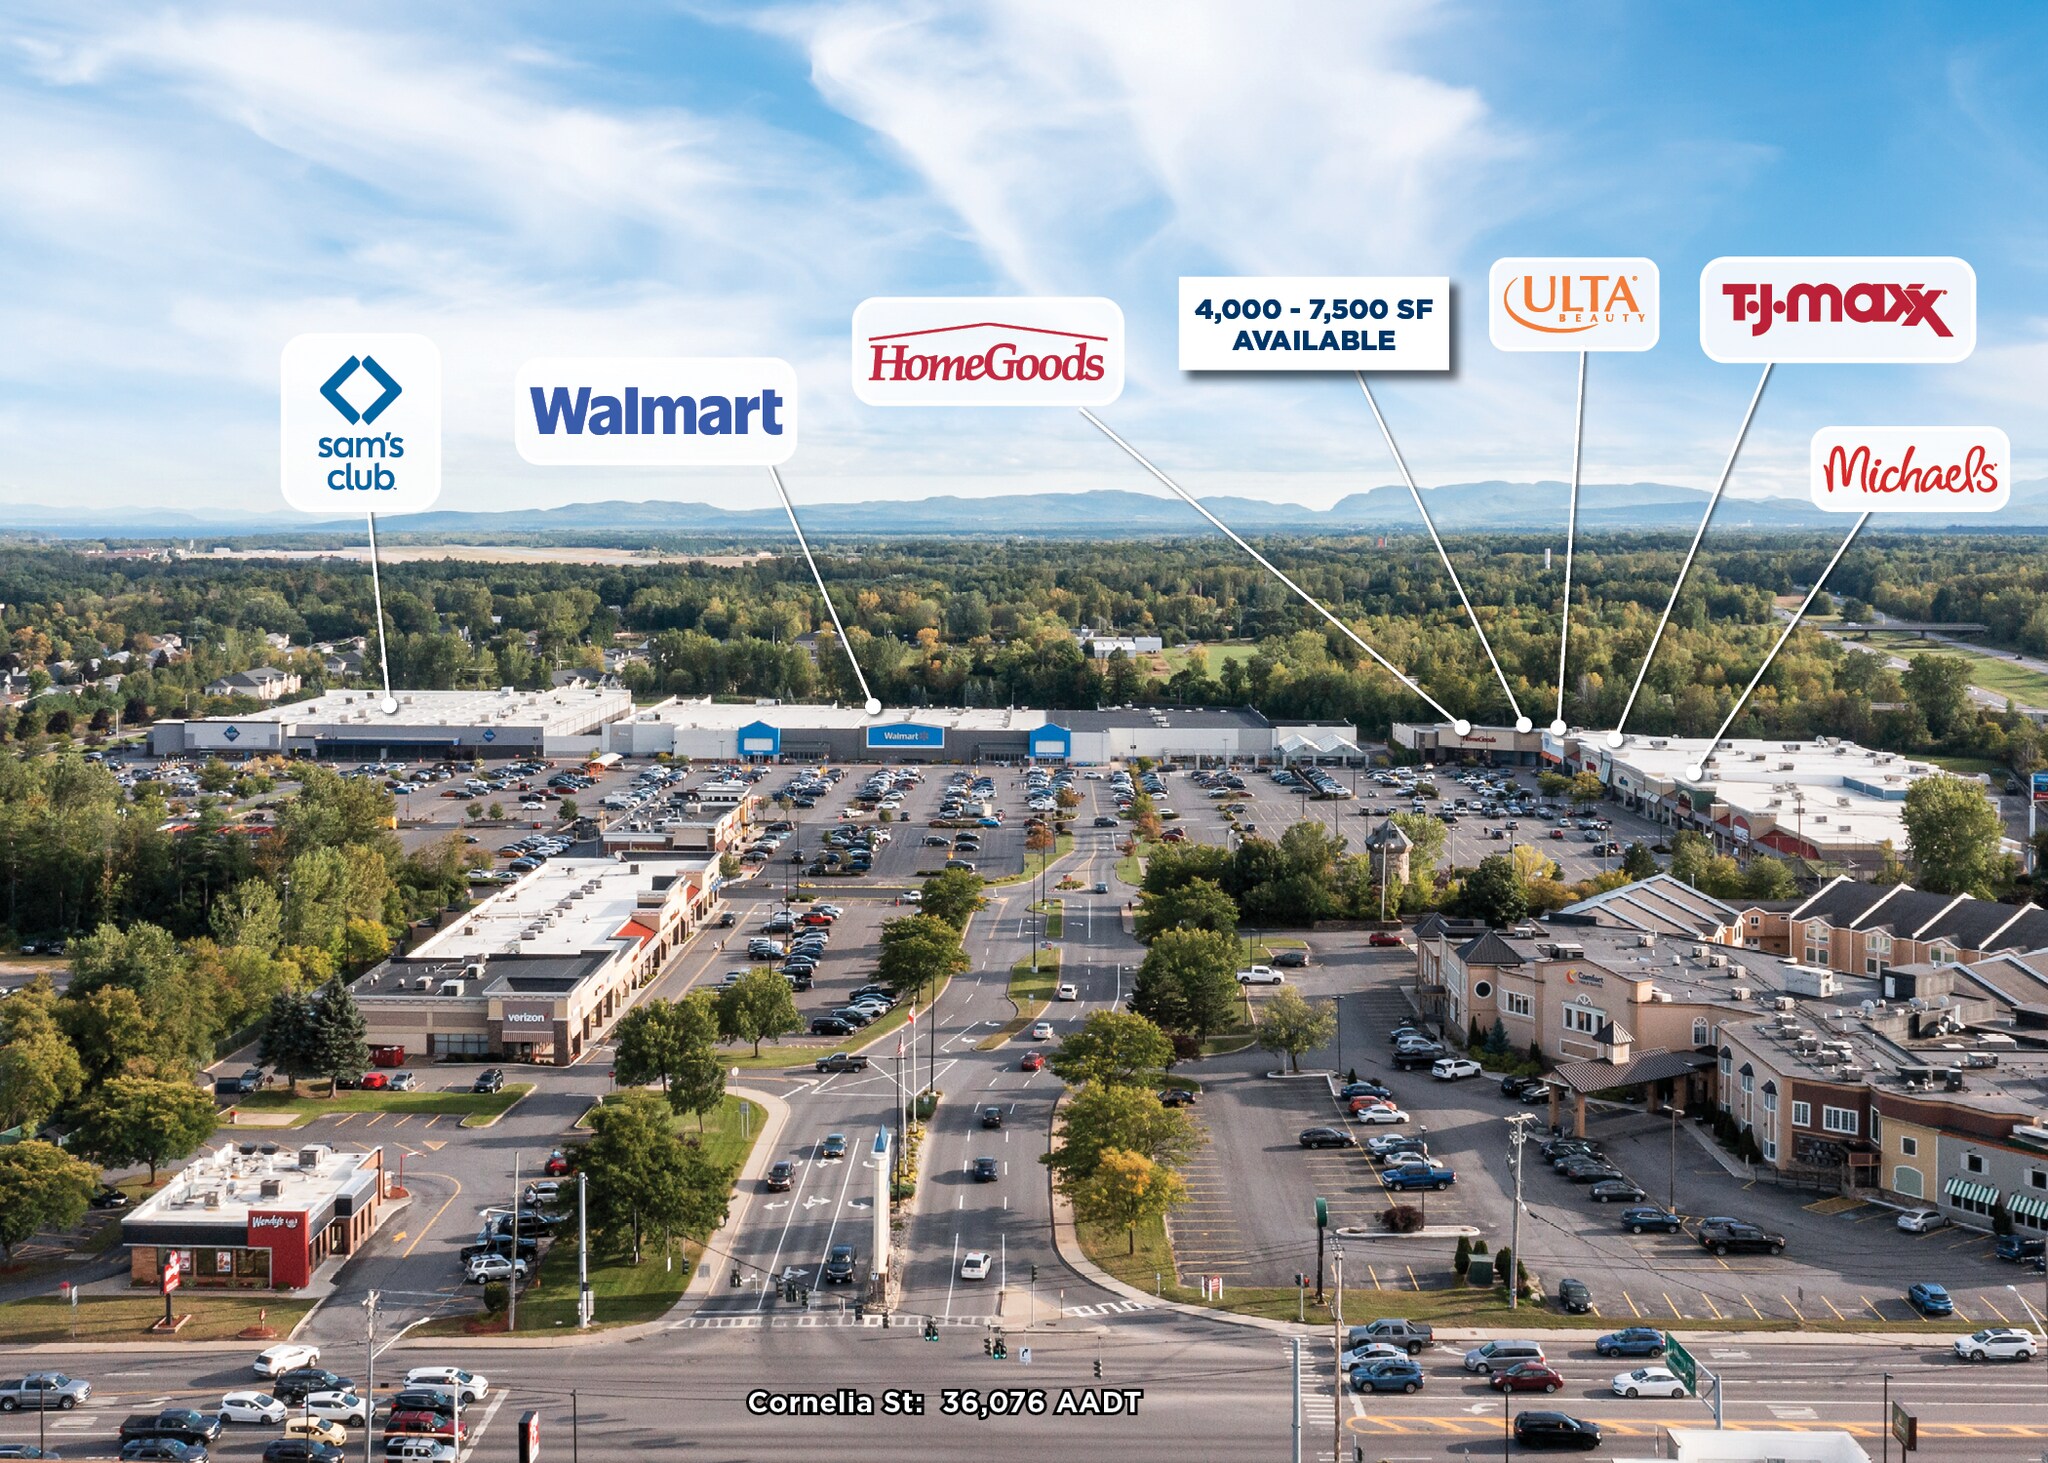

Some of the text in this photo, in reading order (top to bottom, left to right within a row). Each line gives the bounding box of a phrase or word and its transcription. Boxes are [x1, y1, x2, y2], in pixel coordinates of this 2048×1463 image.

[884, 731, 919, 741] Walmart
[508, 1012, 545, 1022] verizon
[252, 1214, 284, 1228] Wendy's
